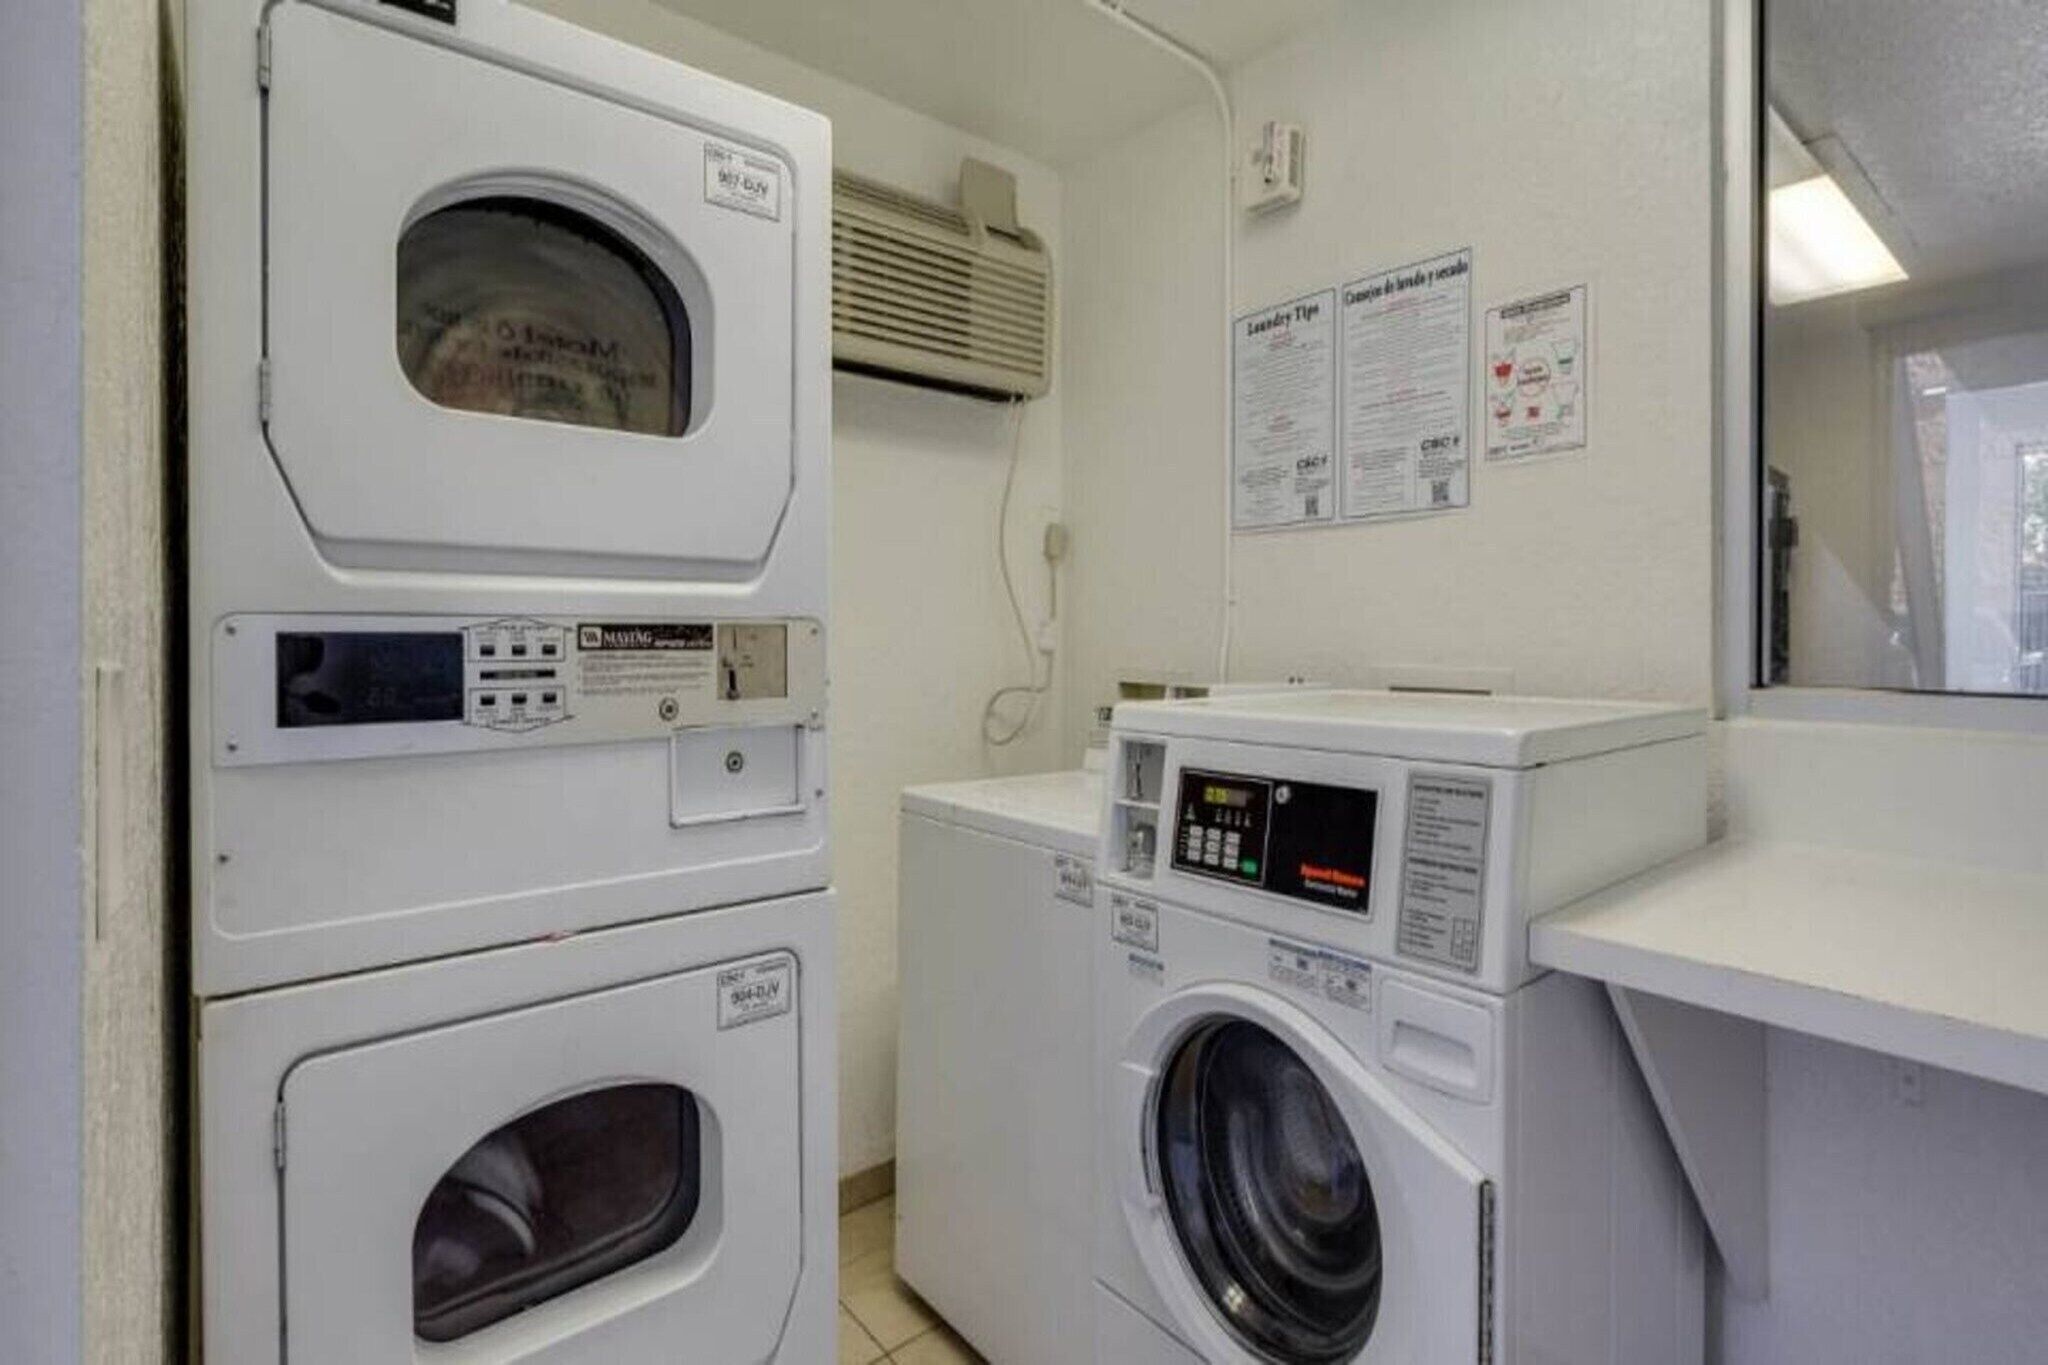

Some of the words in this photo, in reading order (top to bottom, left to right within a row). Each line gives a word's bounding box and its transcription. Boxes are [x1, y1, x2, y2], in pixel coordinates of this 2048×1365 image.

[1384, 278, 1395, 295] de
[1247, 311, 1292, 337] Laundry
[1295, 303, 1319, 323] Tips
[603, 629, 652, 648] MAYTAG
